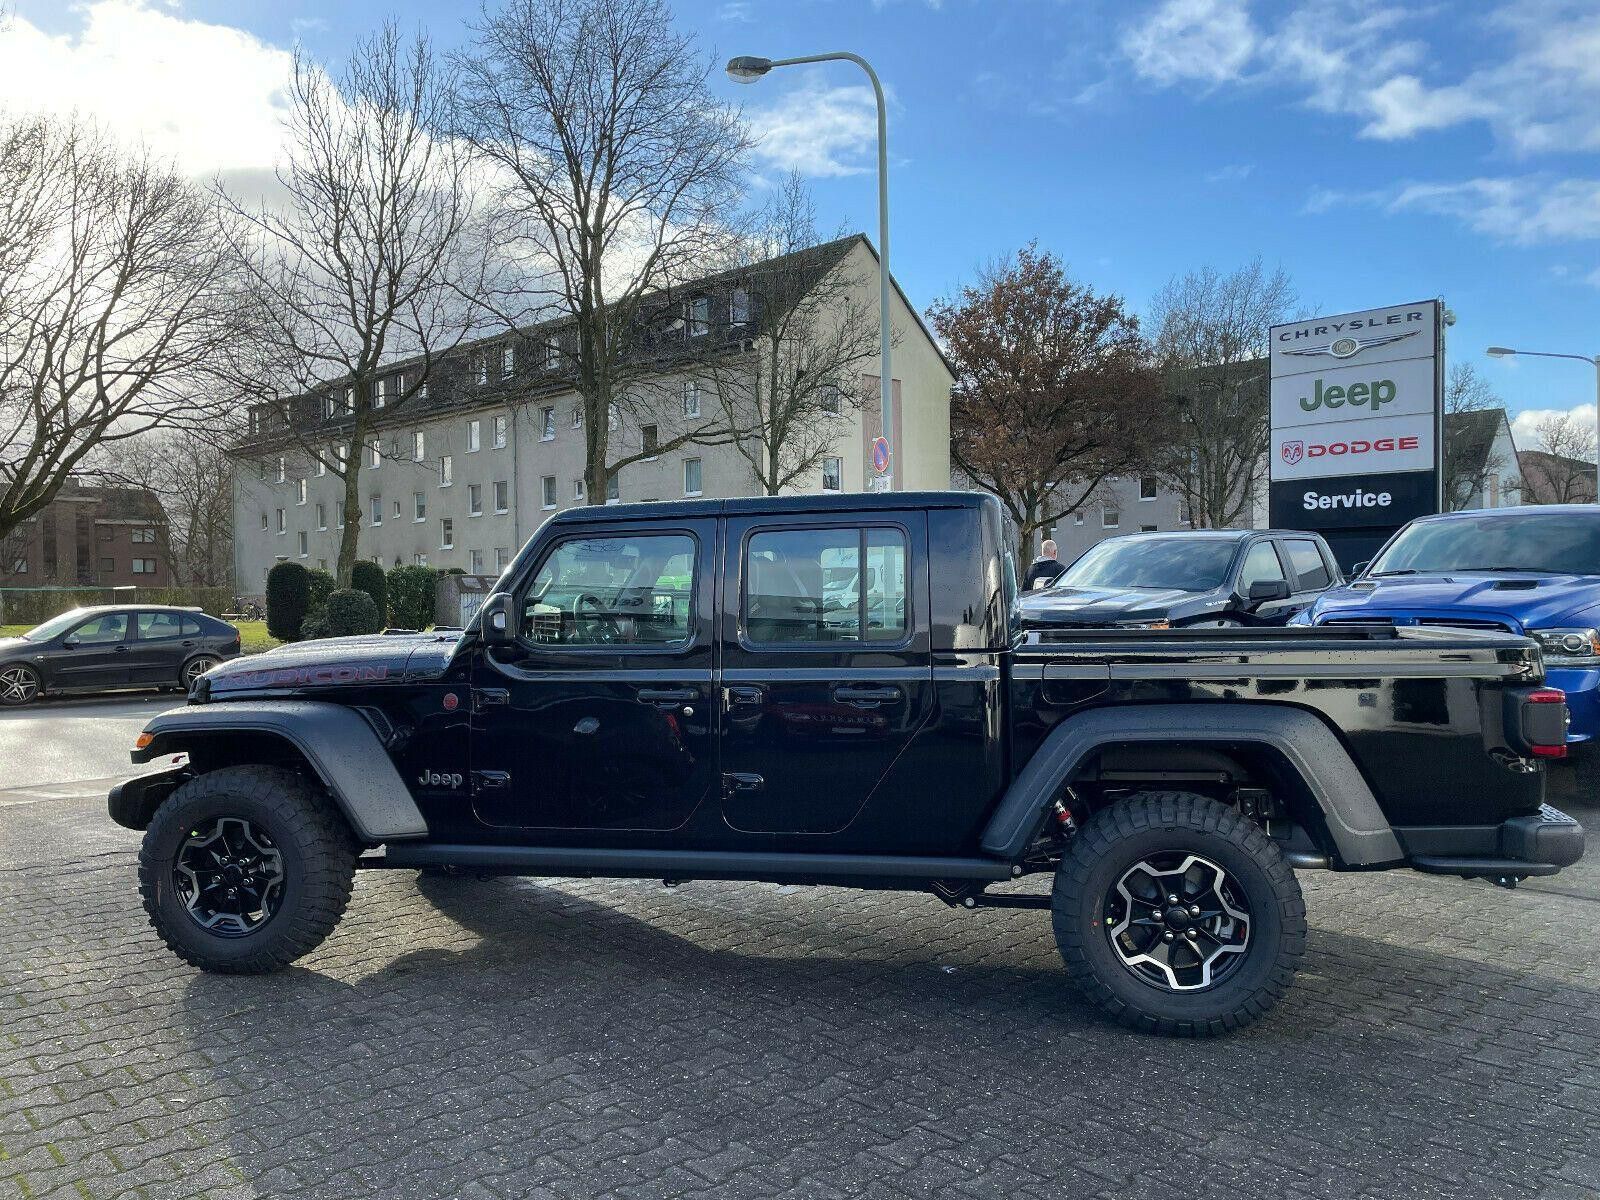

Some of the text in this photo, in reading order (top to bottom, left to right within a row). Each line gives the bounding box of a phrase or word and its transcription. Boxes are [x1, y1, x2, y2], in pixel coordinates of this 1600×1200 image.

[1279, 311, 1423, 342] CHRYSLER
[1299, 379, 1397, 411] Jeep
[1308, 436, 1419, 457] DODGE
[1303, 489, 1392, 510] Service
[418, 769, 463, 789] Jeep
